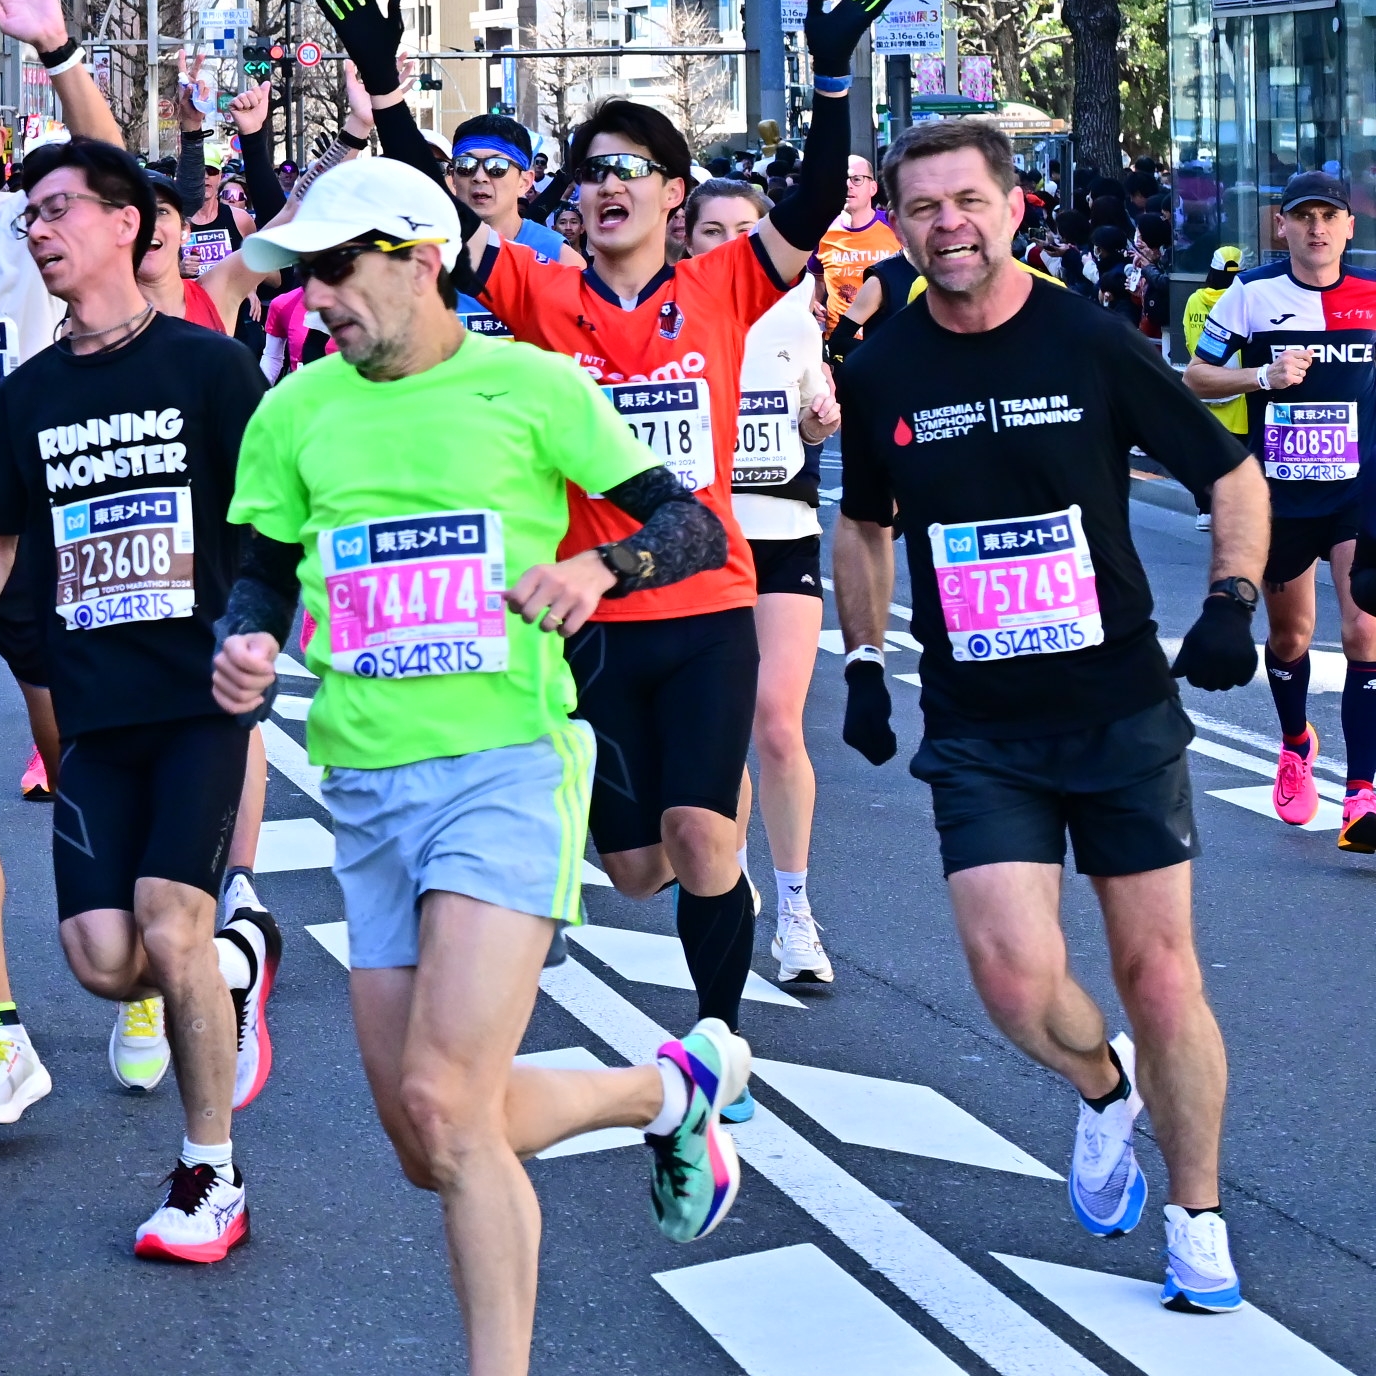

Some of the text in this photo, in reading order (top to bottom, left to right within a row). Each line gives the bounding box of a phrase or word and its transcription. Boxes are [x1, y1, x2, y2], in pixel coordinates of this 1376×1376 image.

[302, 50, 316, 60] 50
[194, 243, 226, 261] 0334
[831, 250, 890, 263] MARTIJN
[1331, 308, 1374, 320] マイケル
[583, 353, 607, 366] NTT
[618, 390, 693, 408] 東京メトロ
[1000, 395, 1069, 413] TEAM IN
[913, 401, 986, 422] LEUKEMIA &
[1001, 408, 1082, 428] TRAINING
[1293, 409, 1346, 420] 東京メトロ
[915, 412, 987, 433] LYMPHOMA
[37, 407, 184, 460] RUNNING
[916, 425, 972, 444] SOCIETY
[1267, 429, 1278, 443] C
[1283, 429, 1345, 455] 60850
[1268, 451, 1276, 461] 2
[46, 442, 188, 493] MONSTER
[745, 468, 787, 481] インカラミ
[1293, 464, 1347, 480] STARTS
[93, 500, 172, 526] 東京メトロ
[375, 525, 479, 553] 東京メトロ
[982, 524, 1069, 551] 東京メトロ
[60, 551, 75, 573] D
[80, 532, 171, 587] 23608
[63, 586, 74, 604] 3
[101, 579, 191, 594] TOKYO MARATHON 2024
[943, 574, 961, 596] C
[969, 561, 1076, 614] 75749
[332, 583, 350, 609] C
[359, 566, 478, 629] 74474
[96, 592, 175, 624] STARTS
[951, 613, 960, 630] 1
[340, 630, 348, 649] 1
[995, 622, 1085, 656] STARTS
[381, 641, 483, 677] STARTS
